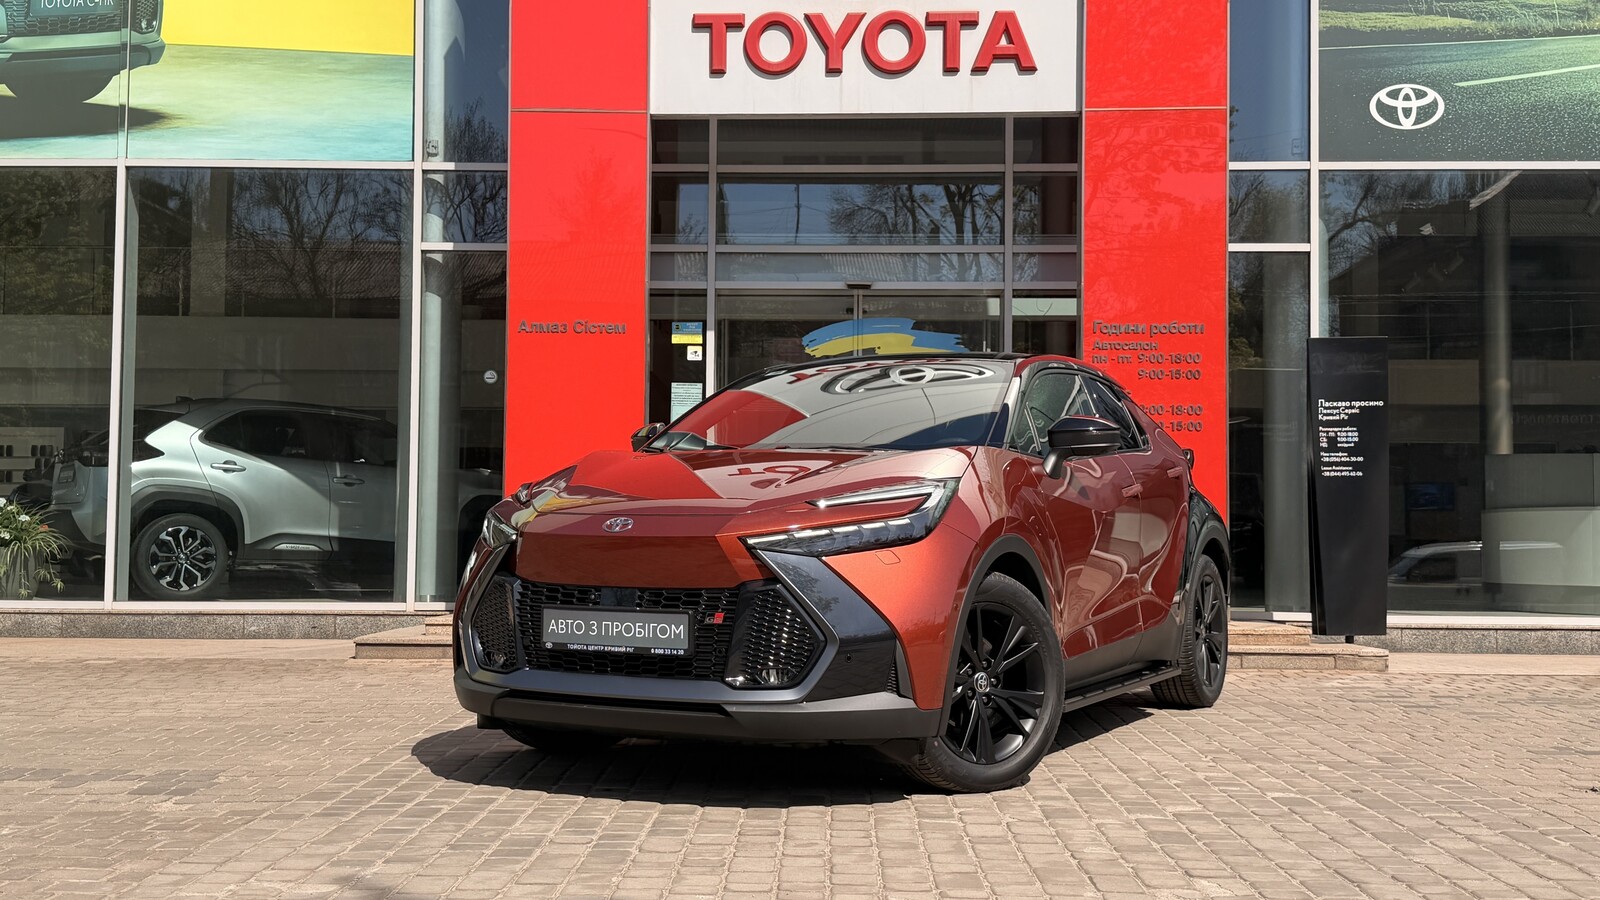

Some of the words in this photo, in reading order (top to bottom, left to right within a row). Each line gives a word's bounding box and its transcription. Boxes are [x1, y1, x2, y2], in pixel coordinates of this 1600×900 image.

[692, 10, 1038, 76] TOYOTA
[518, 320, 568, 334] Алмаз
[573, 320, 627, 334] Сістем
[1092, 321, 1146, 336] Години
[1149, 321, 1204, 337] роботи
[1092, 340, 1158, 351] Автосалон
[1092, 355, 1108, 364] пн
[1137, 353, 1202, 365] 9:00-18:00
[1137, 369, 1202, 380] 9:00-15:00
[1318, 399, 1350, 407] Ласкаво
[1340, 406, 1360, 414] Сервіс
[548, 619, 585, 635] АВТО
[602, 621, 684, 639] ПРОБІГОМ
